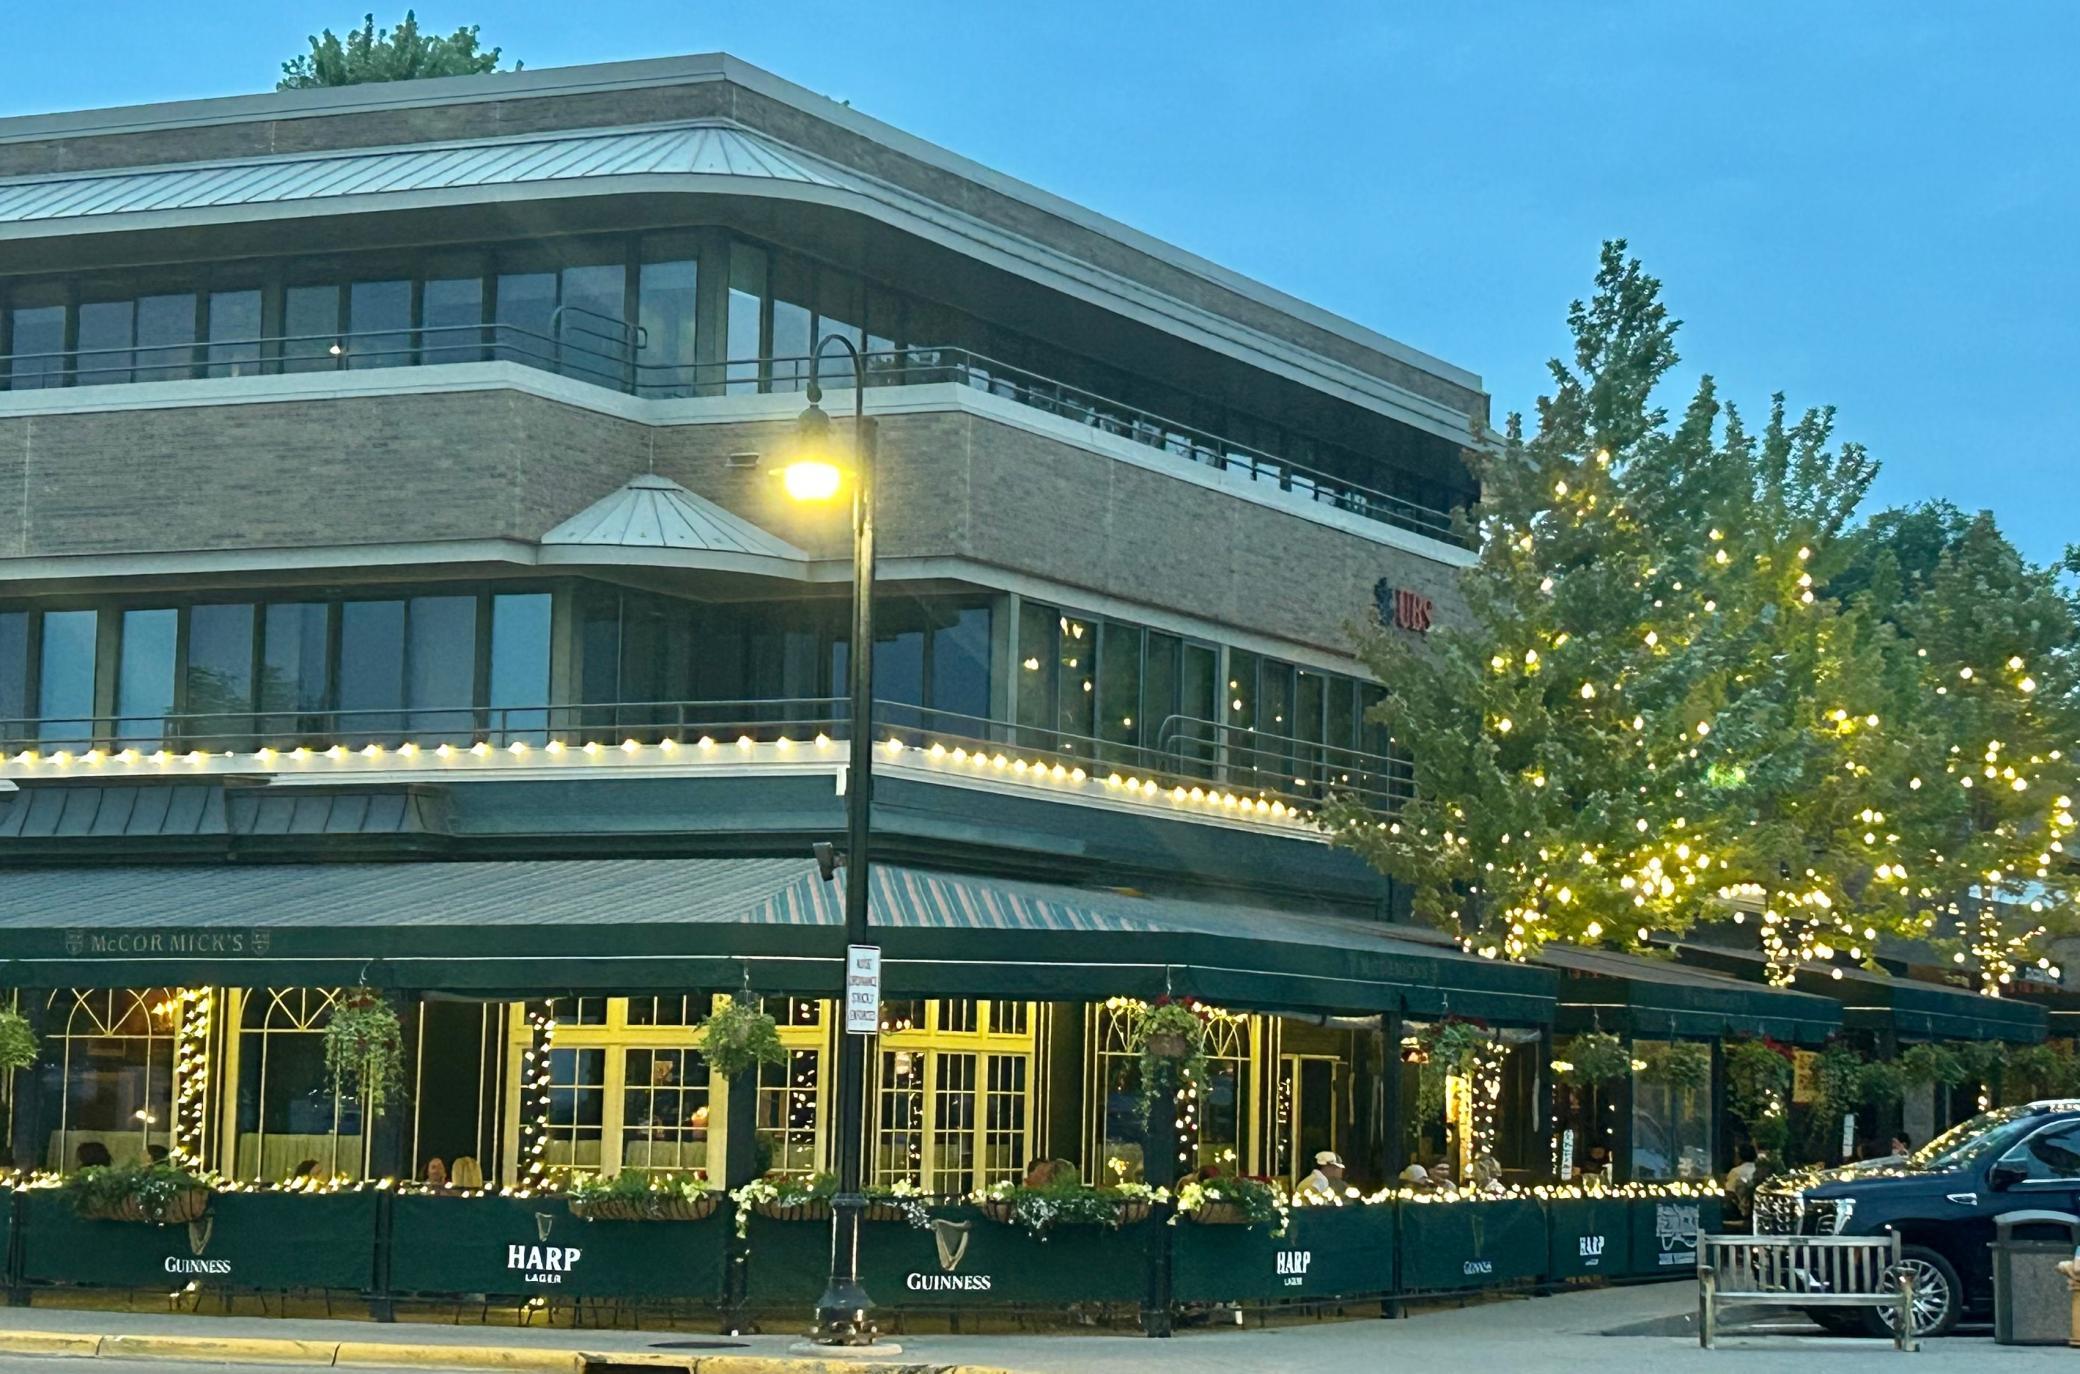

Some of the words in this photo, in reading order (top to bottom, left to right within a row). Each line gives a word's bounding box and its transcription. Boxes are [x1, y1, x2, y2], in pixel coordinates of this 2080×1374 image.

[1395, 589, 1432, 630] UBS
[507, 1244, 581, 1271] HARP
[1276, 1251, 1311, 1274] HARP
[906, 1272, 991, 1290] GUINNESS
